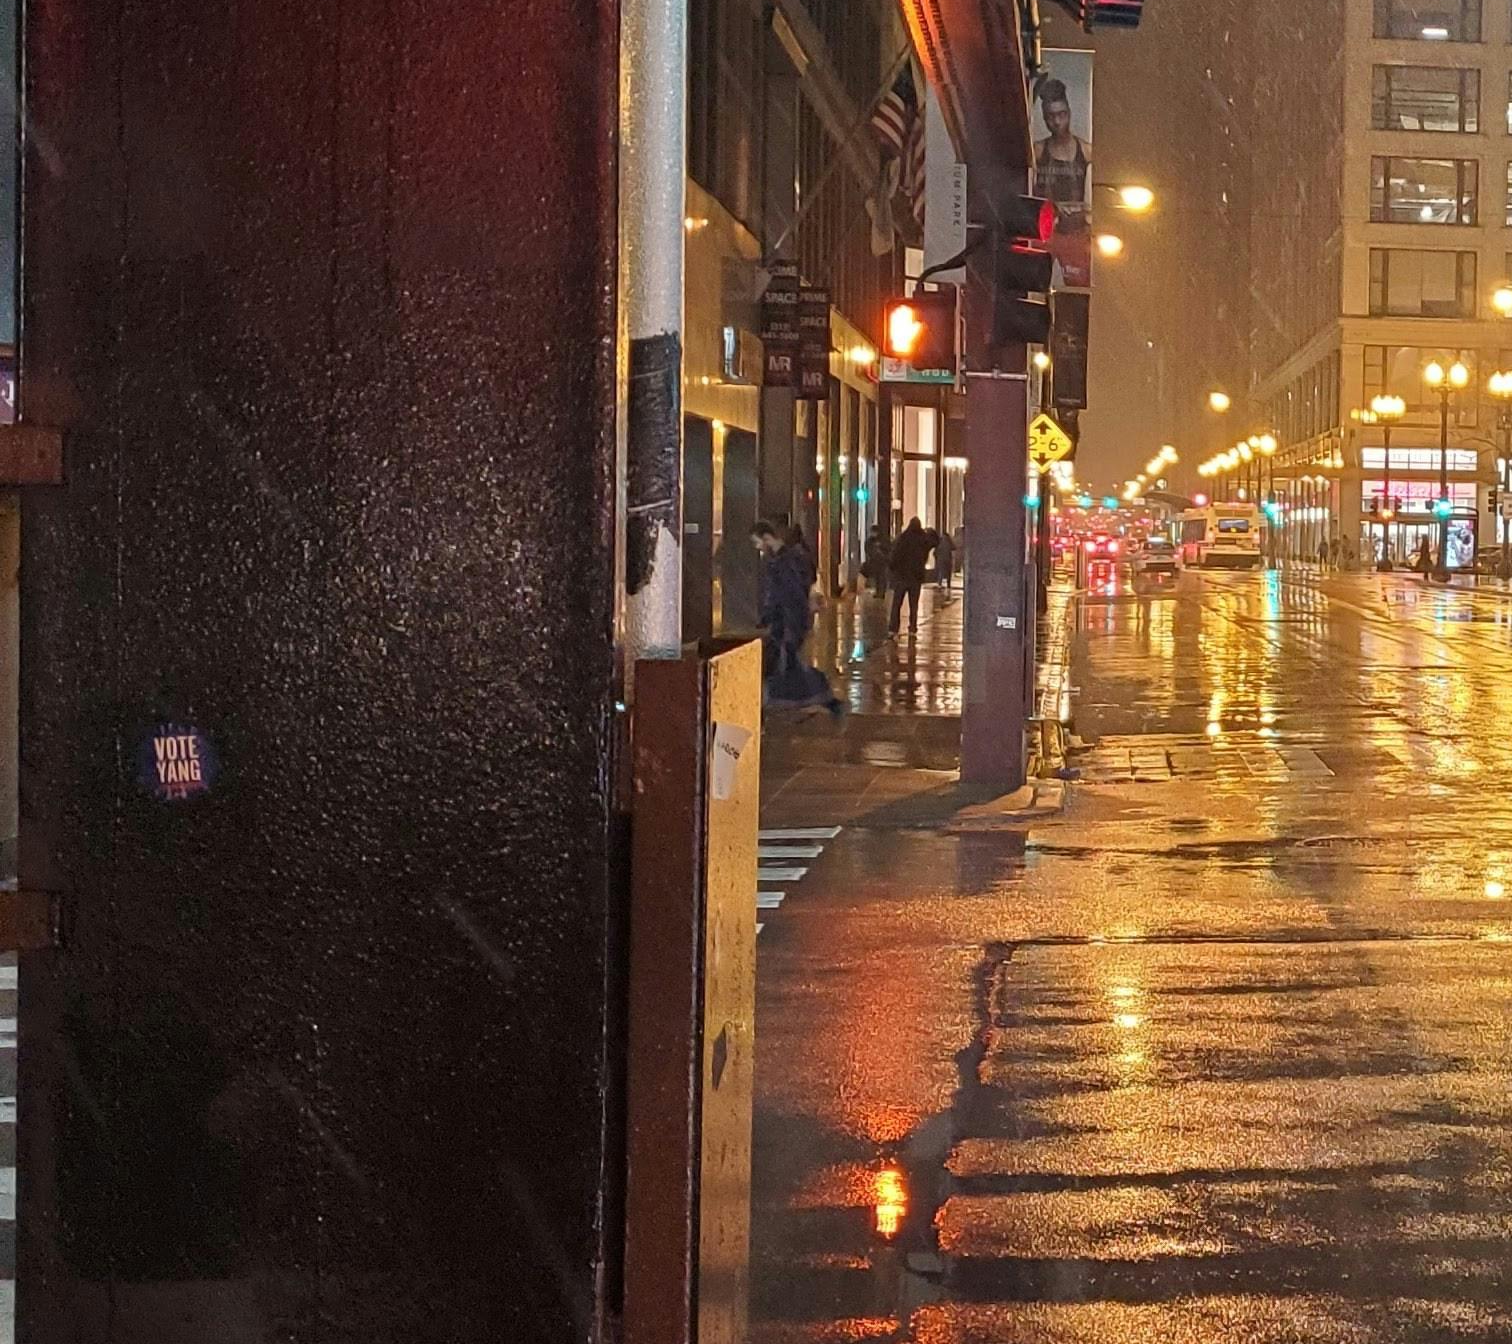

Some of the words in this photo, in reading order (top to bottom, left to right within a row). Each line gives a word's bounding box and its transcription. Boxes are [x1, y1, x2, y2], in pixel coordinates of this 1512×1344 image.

[765, 292, 798, 304] SPACE
[153, 735, 200, 761] VOTE
[156, 759, 202, 784] YANG
